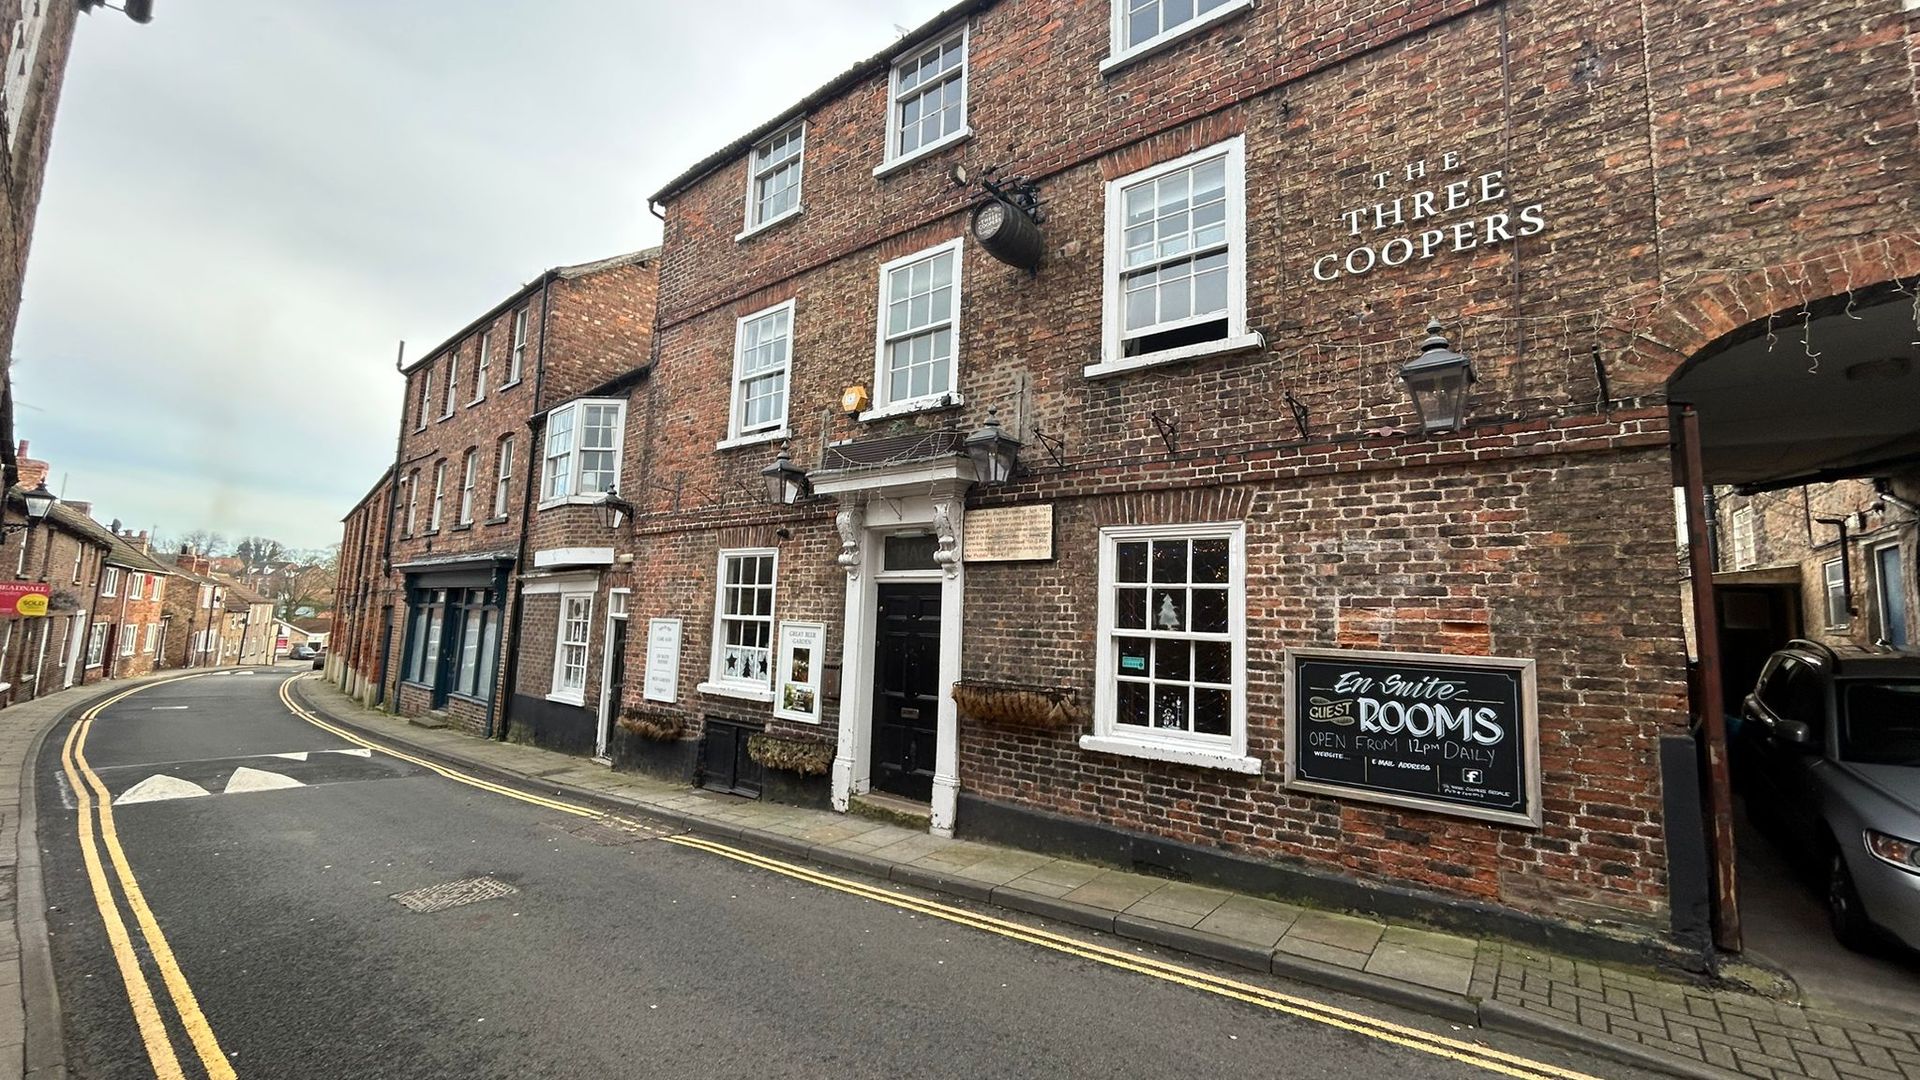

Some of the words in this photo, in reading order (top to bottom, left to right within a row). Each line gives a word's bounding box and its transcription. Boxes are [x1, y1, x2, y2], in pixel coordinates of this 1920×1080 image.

[1373, 150, 1460, 190] THE
[1341, 170, 1505, 236] THREE
[1313, 204, 1545, 281] COOPERS
[1334, 671, 1375, 694] En
[1379, 674, 1469, 700] Suite
[1309, 702, 1353, 718] GUEST
[1357, 697, 1504, 746] ROOMS
[1309, 731, 1346, 749] OPEN
[1355, 736, 1398, 752] FROM
[1408, 739, 1440, 755] 12pm
[1444, 740, 1496, 768] DAILY
